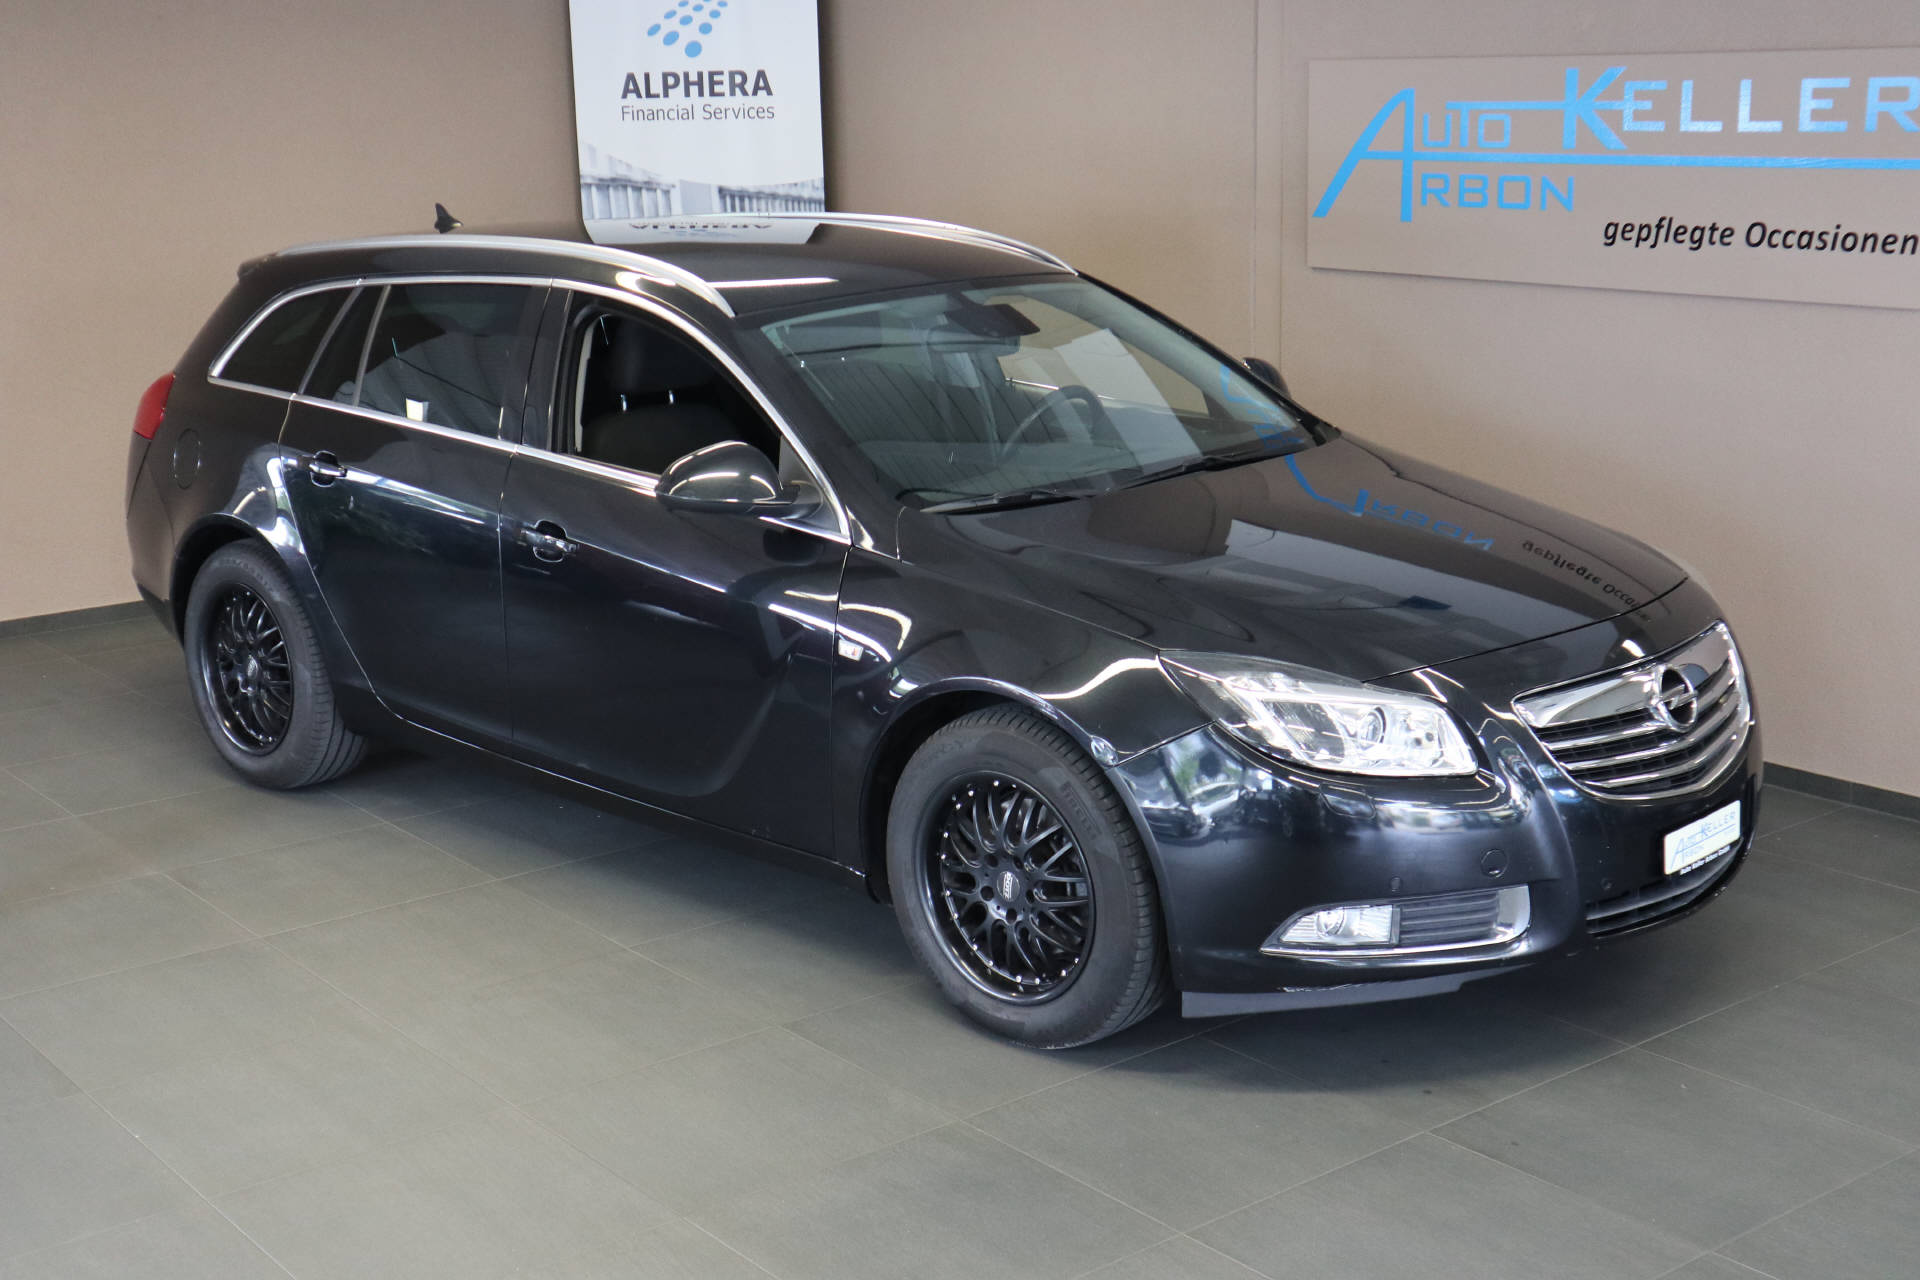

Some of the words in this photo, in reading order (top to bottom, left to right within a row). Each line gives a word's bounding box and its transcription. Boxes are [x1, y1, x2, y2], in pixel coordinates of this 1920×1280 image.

[620, 69, 774, 99] ALPHERA
[621, 104, 695, 121] Financial
[702, 104, 775, 121] Services
[1562, 66, 1920, 149] KELLER
[1603, 216, 1735, 251] gepflegte
[1745, 221, 1919, 256] Occasionen
